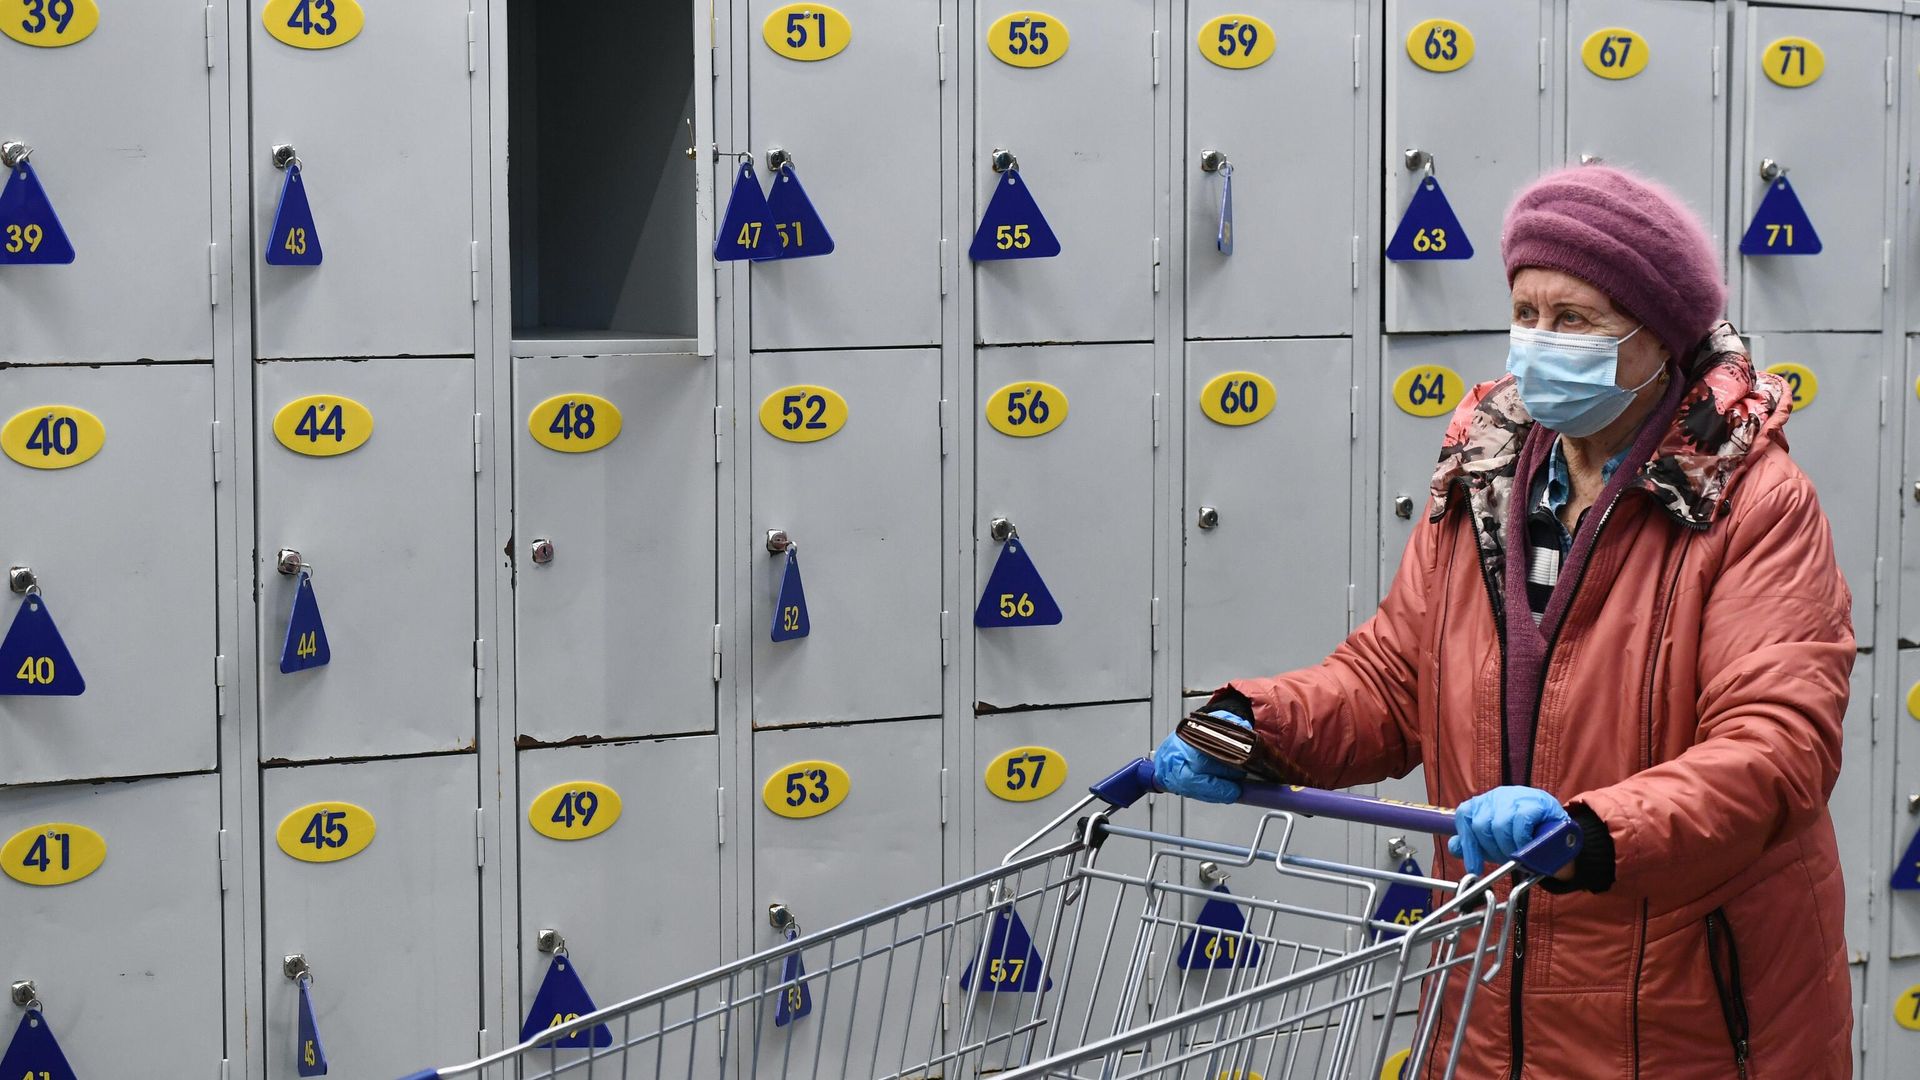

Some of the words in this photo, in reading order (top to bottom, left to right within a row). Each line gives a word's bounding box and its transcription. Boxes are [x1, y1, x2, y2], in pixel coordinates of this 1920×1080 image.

[22, 0, 74, 34] 39
[287, 0, 337, 36] 43
[786, 13, 826, 48] 51
[1008, 21, 1049, 55] 55
[1217, 23, 1258, 57] 59
[1424, 27, 1458, 61] 63
[1599, 37, 1632, 68] 67
[1779, 45, 1806, 76] 71
[5, 224, 43, 253] 39
[285, 227, 306, 255] 43
[737, 222, 762, 248] 47
[996, 224, 1031, 250] 55
[1413, 228, 1447, 252] 63
[1765, 224, 1794, 247] 71
[1219, 380, 1259, 414] 60
[1408, 373, 1446, 406] 64
[1775, 371, 1802, 402] 2
[295, 404, 345, 442] 44
[549, 402, 595, 440] 48
[782, 395, 827, 430] 52
[1007, 391, 1049, 426] 56
[26, 415, 78, 456] 40
[784, 605, 799, 632] 52
[999, 592, 1035, 619] 56
[297, 630, 317, 659] 44
[16, 656, 55, 684] 40
[786, 769, 829, 807] 53
[1006, 755, 1046, 791] 57
[551, 791, 598, 828] 49
[300, 811, 349, 849] 45
[22, 832, 70, 873] 41
[1204, 936, 1235, 960] 61
[990, 959, 1025, 983] 57
[304, 1040, 316, 1067] 45
